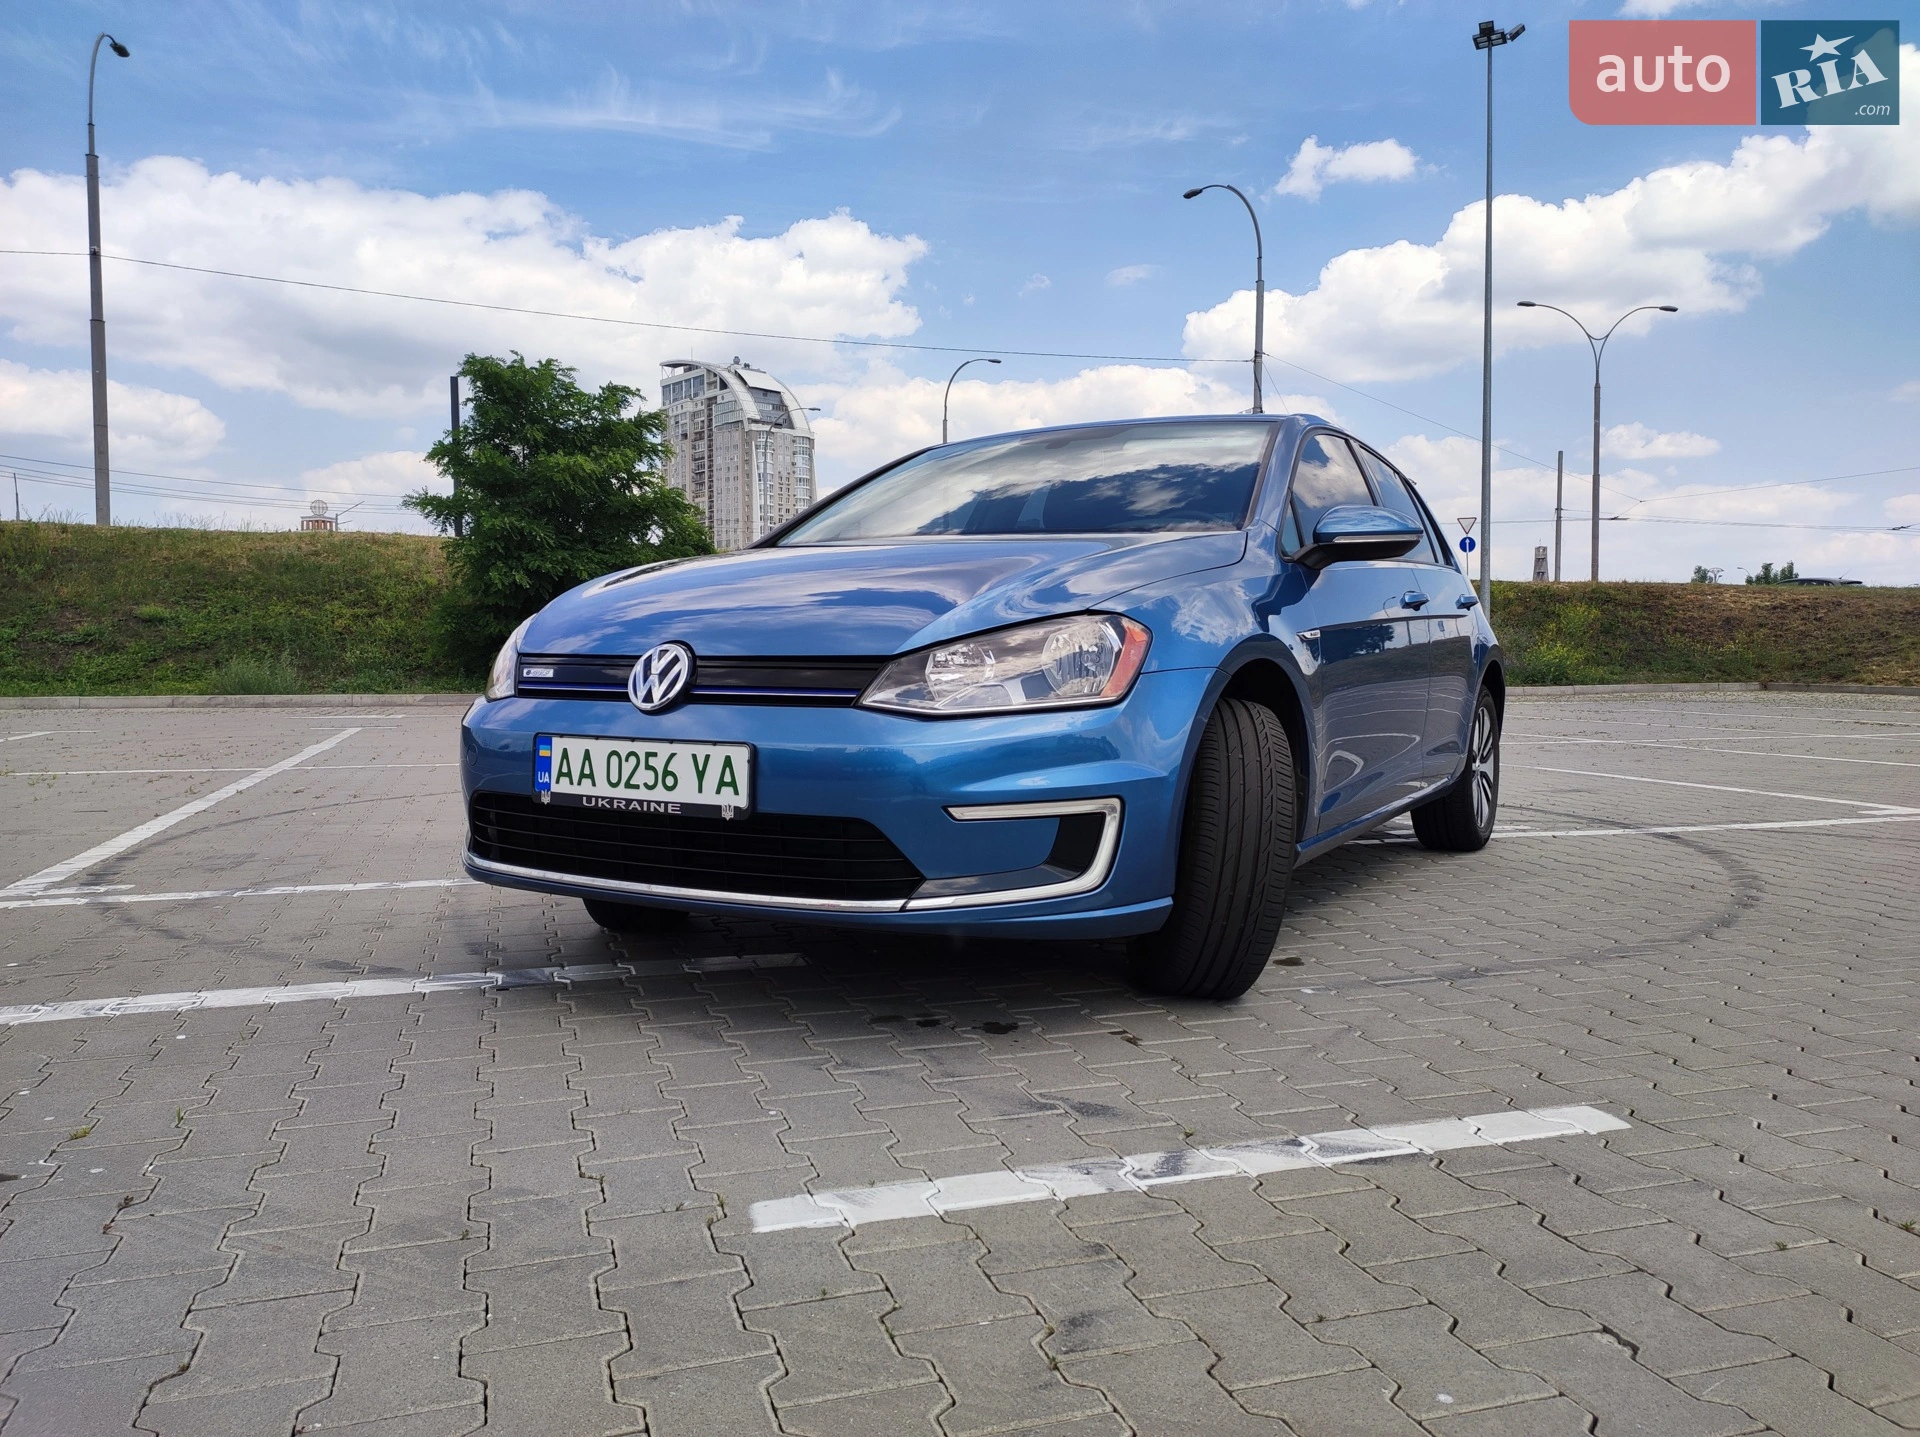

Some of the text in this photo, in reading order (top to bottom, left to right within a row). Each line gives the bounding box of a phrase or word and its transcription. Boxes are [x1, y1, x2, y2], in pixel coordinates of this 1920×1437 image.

[537, 771, 550, 783] UA
[555, 747, 740, 796] AA 0256 YA
[582, 796, 682, 815] UKRAINE
